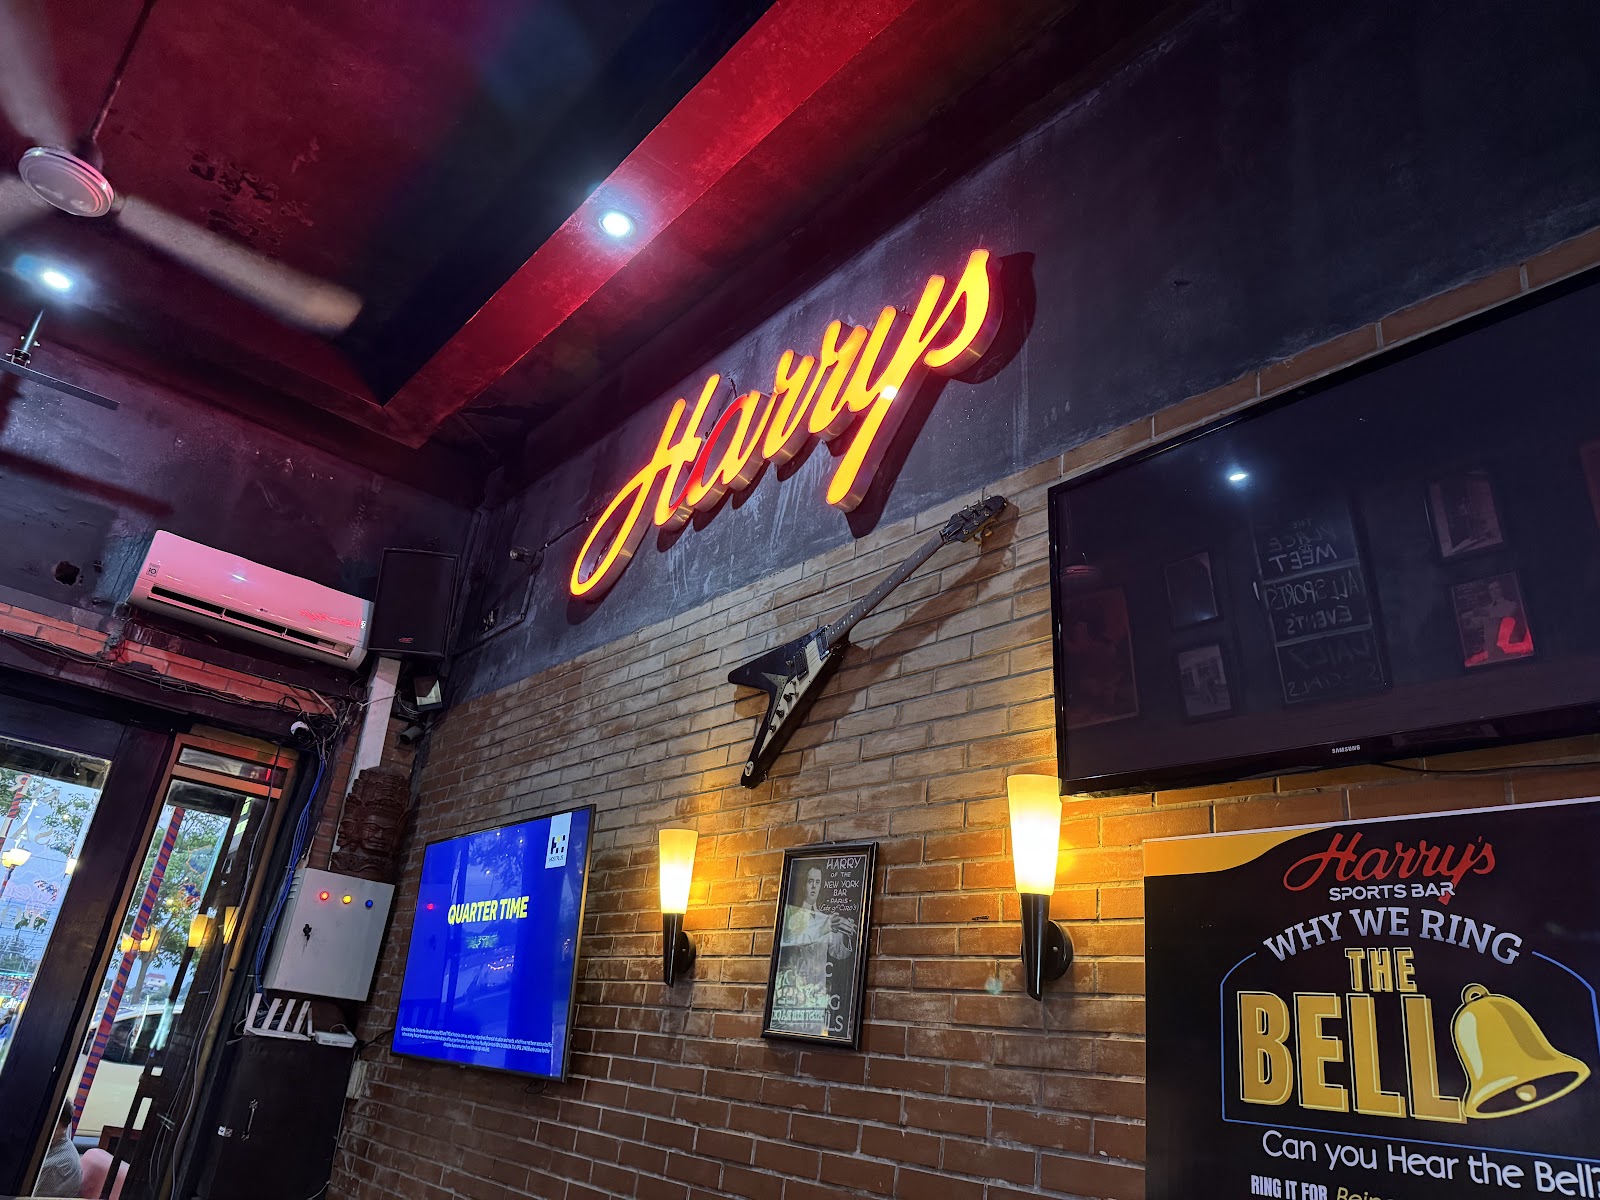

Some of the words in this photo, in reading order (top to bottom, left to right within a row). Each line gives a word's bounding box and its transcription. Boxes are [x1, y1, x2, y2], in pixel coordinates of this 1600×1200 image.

[1331, 745, 1360, 754] SAMSUNG
[826, 857, 861, 870] HARRY
[1283, 831, 1496, 906] Harry's
[824, 880, 839, 888] NEW
[841, 880, 859, 888] YORK
[1329, 884, 1407, 901] SPORTS
[1411, 881, 1455, 898] BAR
[448, 900, 498, 925] QUARTER
[500, 896, 529, 920] TIME
[1263, 911, 1343, 962] WHY
[1349, 906, 1410, 937] WE
[1420, 908, 1524, 965] RING
[1345, 948, 1418, 993] THE
[1237, 991, 1467, 1124] BELL
[1262, 1129, 1317, 1162] Can
[1324, 1143, 1377, 1171] you
[1386, 1144, 1459, 1180] Hear
[1467, 1153, 1525, 1189] the
[1251, 1175, 1282, 1199] RING
[1285, 1180, 1297, 1200] IT
[1301, 1182, 1328, 1200] FOR
